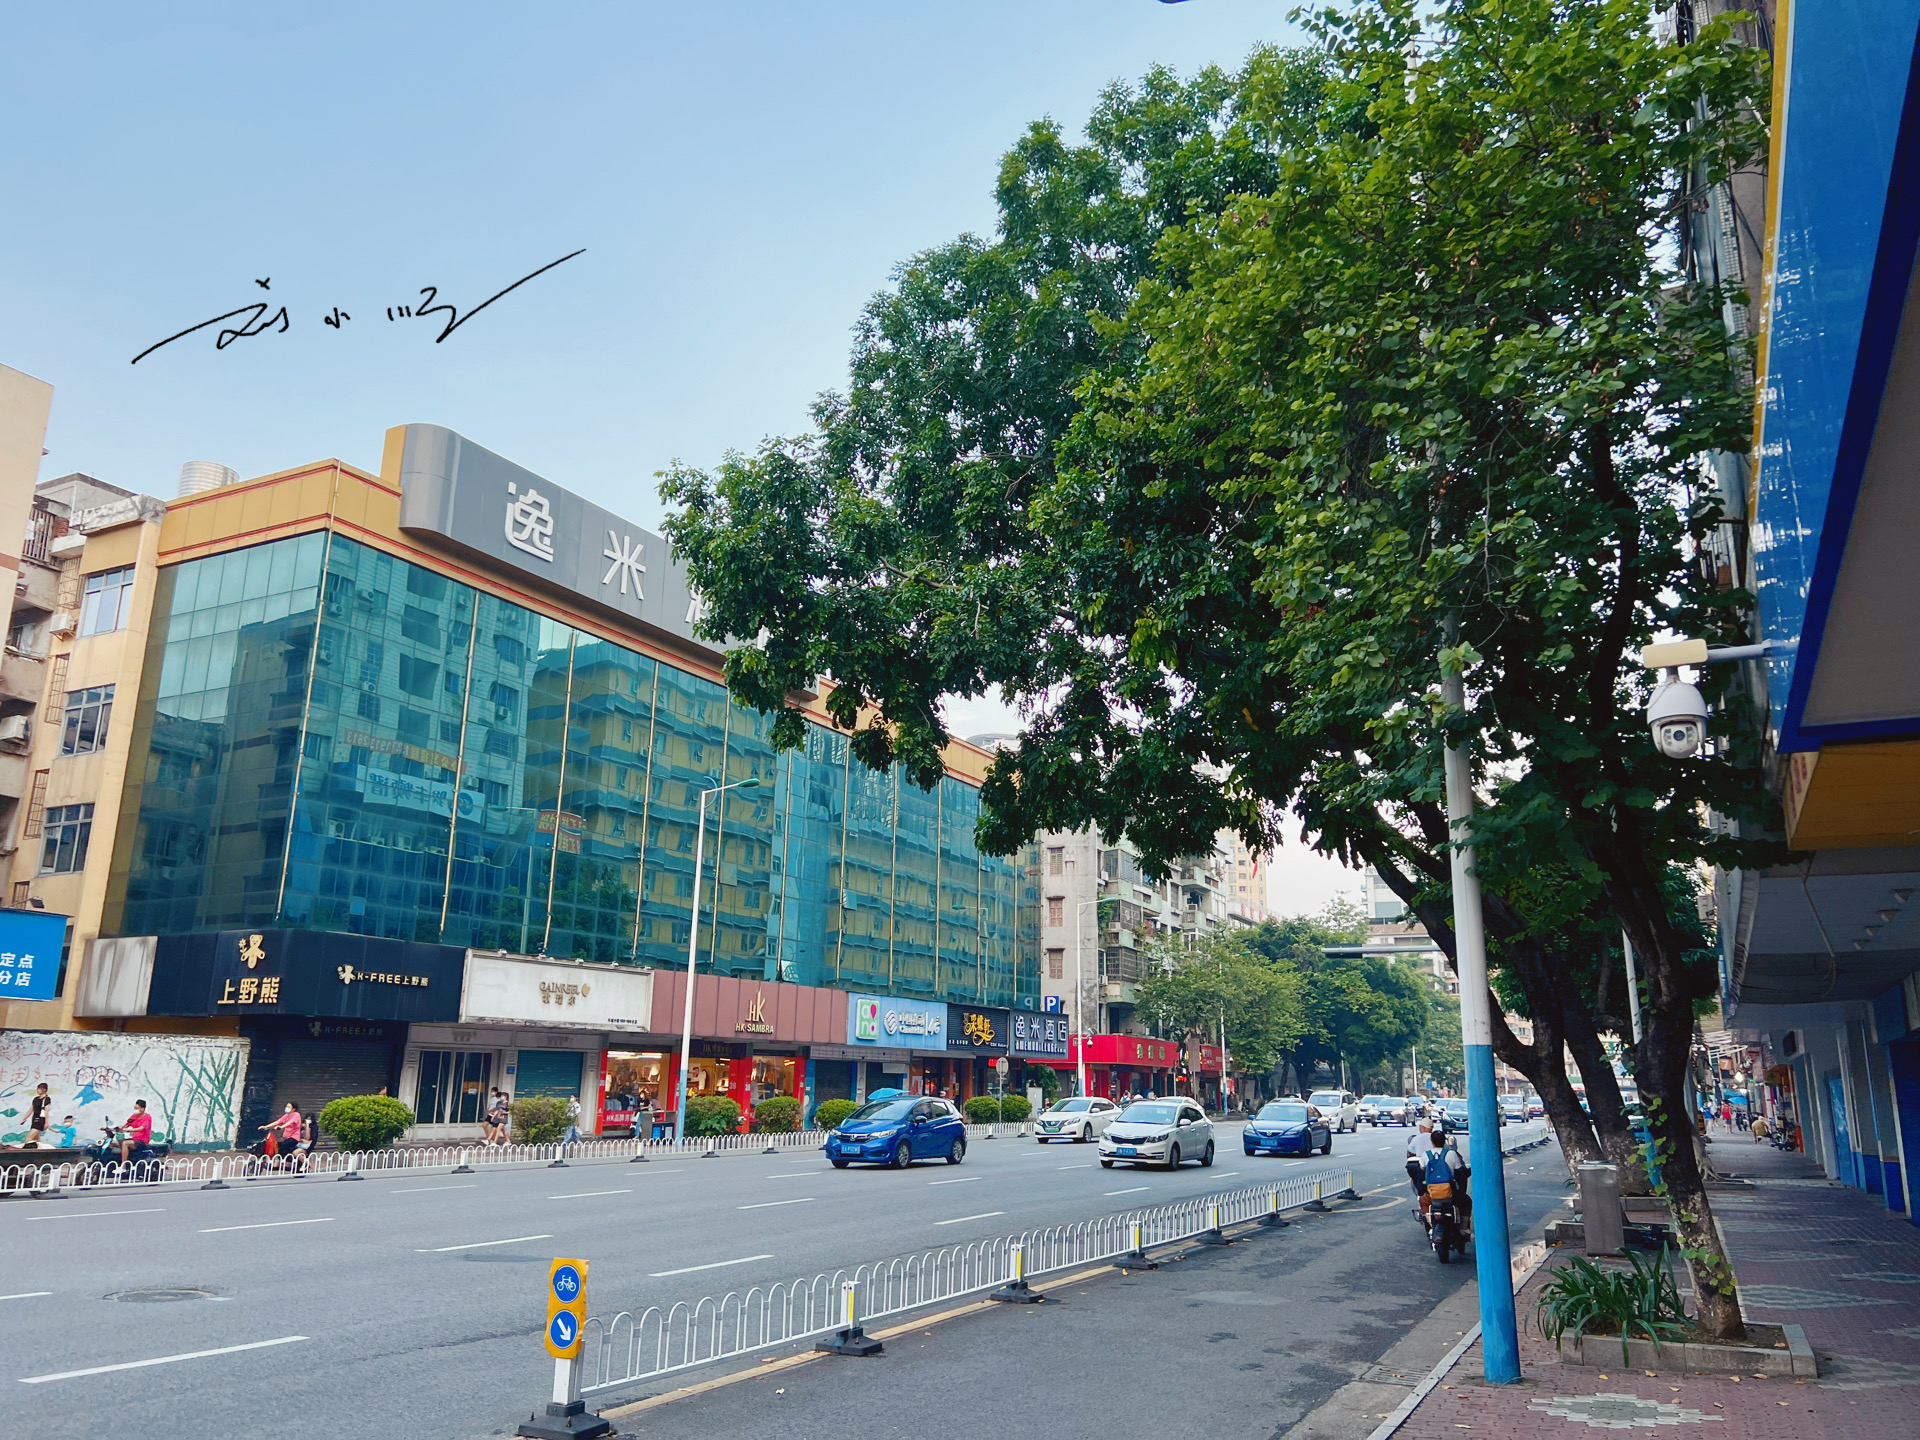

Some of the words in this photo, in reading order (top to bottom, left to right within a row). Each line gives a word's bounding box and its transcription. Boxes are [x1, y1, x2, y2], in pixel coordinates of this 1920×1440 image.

[217, 976, 280, 1004] 上野熊
[1046, 996, 1057, 1012] P
[928, 1016, 941, 1036] 4G
[1015, 1015, 1067, 1041] 逸米酒店
